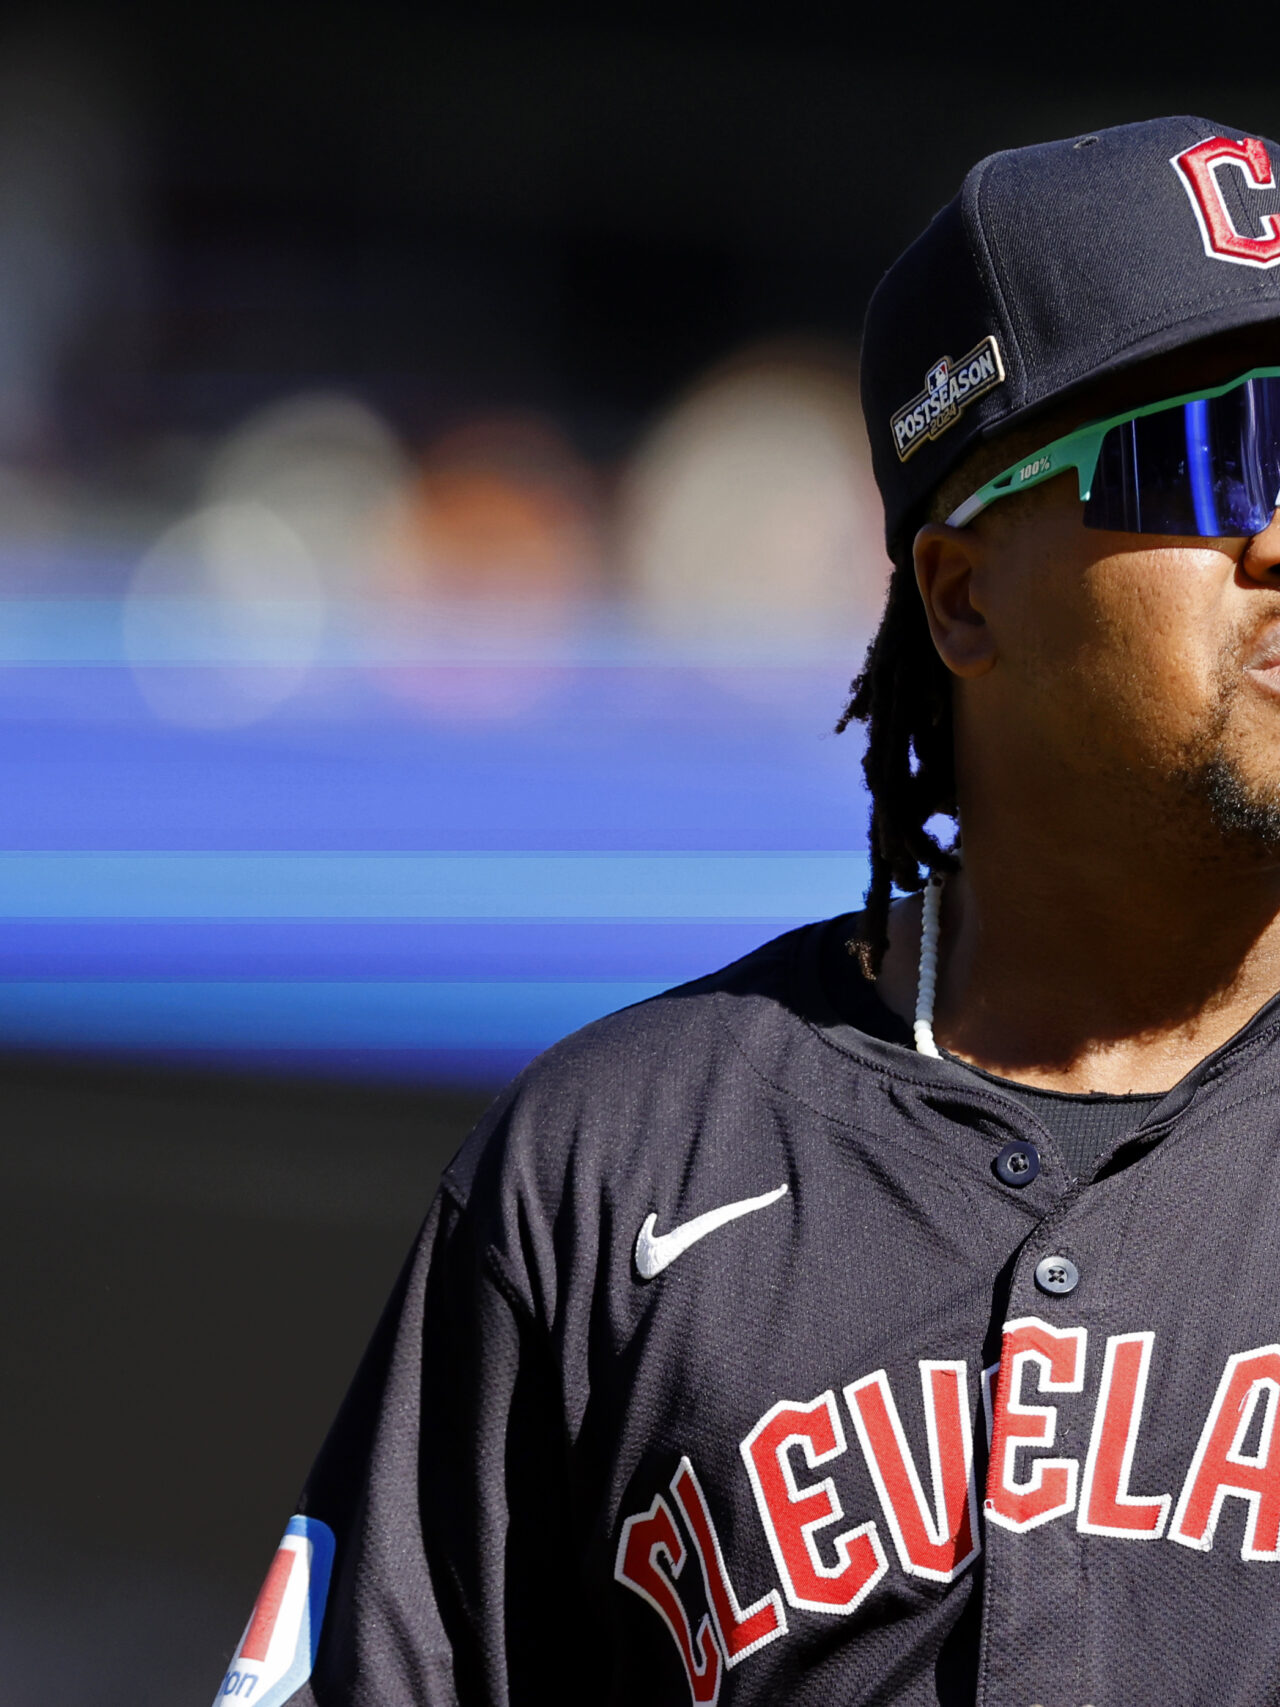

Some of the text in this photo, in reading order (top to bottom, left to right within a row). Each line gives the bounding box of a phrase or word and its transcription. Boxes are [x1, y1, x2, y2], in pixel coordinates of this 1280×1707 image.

[894, 351, 995, 448] POSTSEASON
[930, 403, 957, 431] 2024
[1019, 456, 1050, 481] 100%
